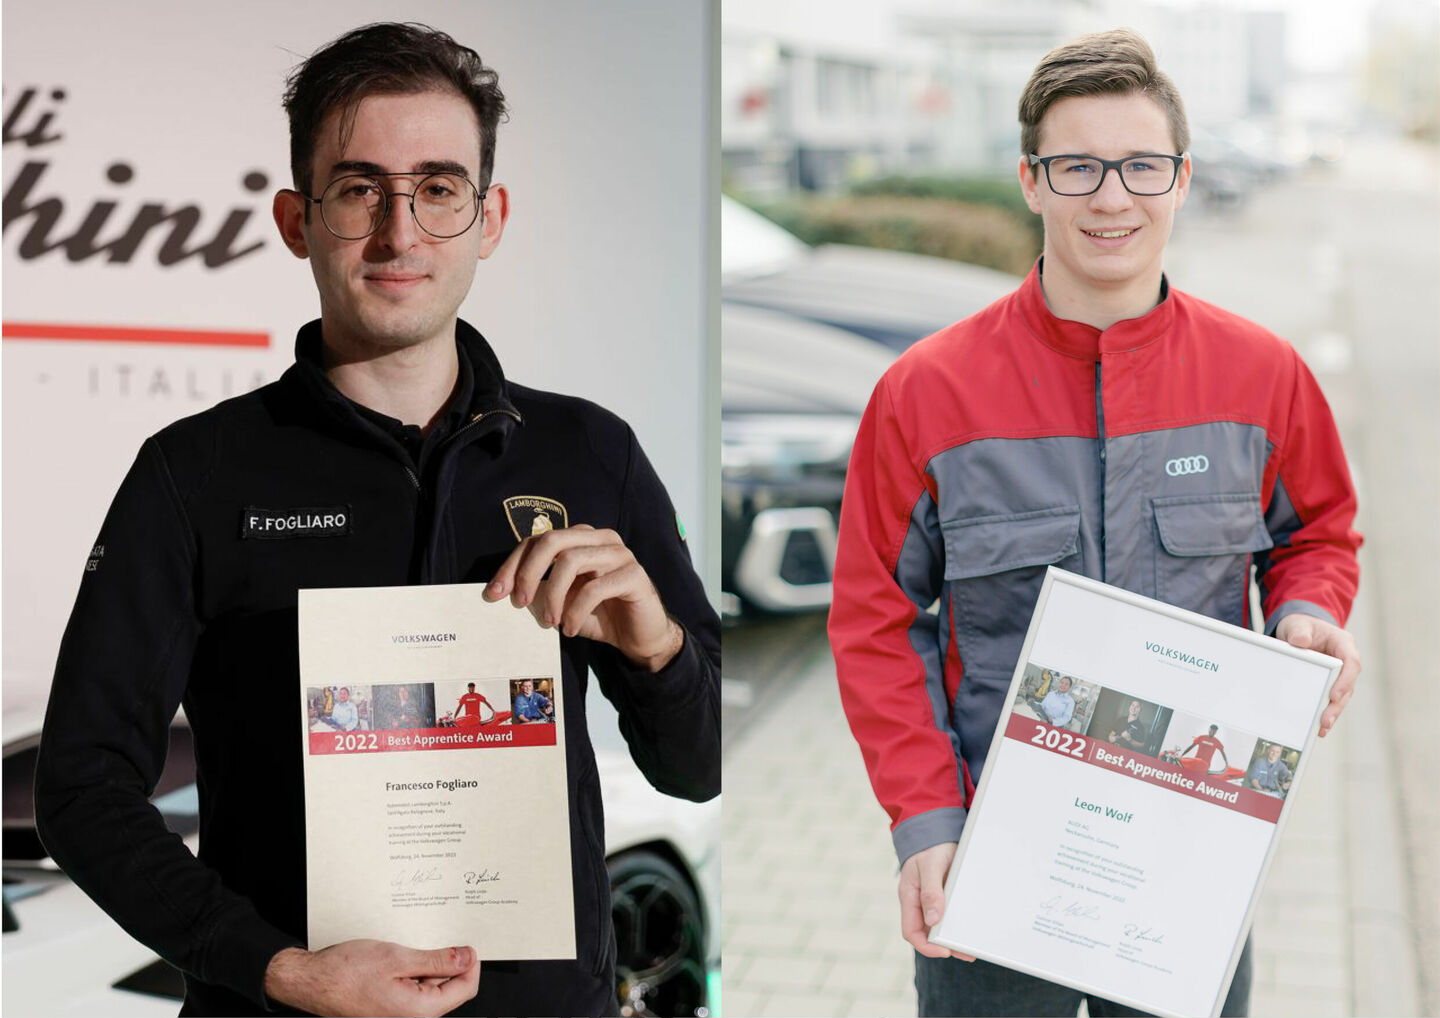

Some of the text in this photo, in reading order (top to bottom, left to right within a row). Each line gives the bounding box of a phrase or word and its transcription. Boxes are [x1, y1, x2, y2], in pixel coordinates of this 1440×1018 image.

[509, 500, 562, 515] LAMBORGHINI
[249, 513, 346, 531] F.FOGLIARO
[392, 633, 457, 643] VOLKSWAGEN
[1145, 641, 1219, 672] VOLKSWAGEN
[334, 731, 513, 750] 2022 Best Apprentice Award
[1031, 725, 1239, 805] 2022 Best Apprentice Award
[386, 779, 478, 791] Francesco Fogliaro
[1074, 797, 1134, 823] Leon Wolf
